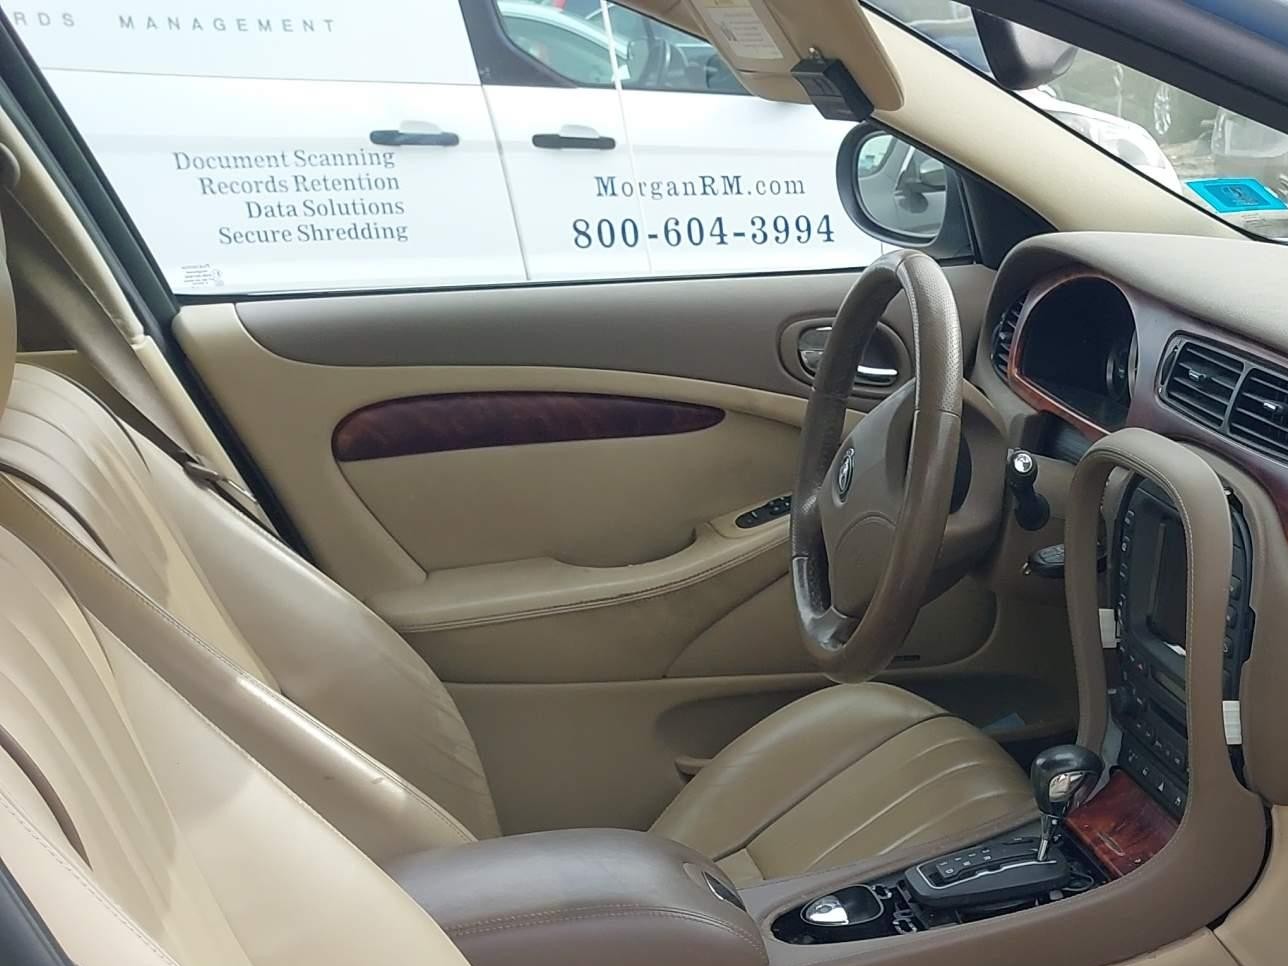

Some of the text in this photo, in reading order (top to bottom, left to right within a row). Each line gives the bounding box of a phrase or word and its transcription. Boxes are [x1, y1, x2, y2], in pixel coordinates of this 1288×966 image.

[119, 15, 335, 33] MANAGEMENT
[173, 148, 396, 171] Document Scanning
[198, 172, 400, 196] Records Retention
[594, 175, 806, 200] MorganRM.com
[245, 198, 405, 219] Data Solutions
[218, 222, 409, 245] Secure Shredding
[571, 214, 836, 249] 800-604-3994
